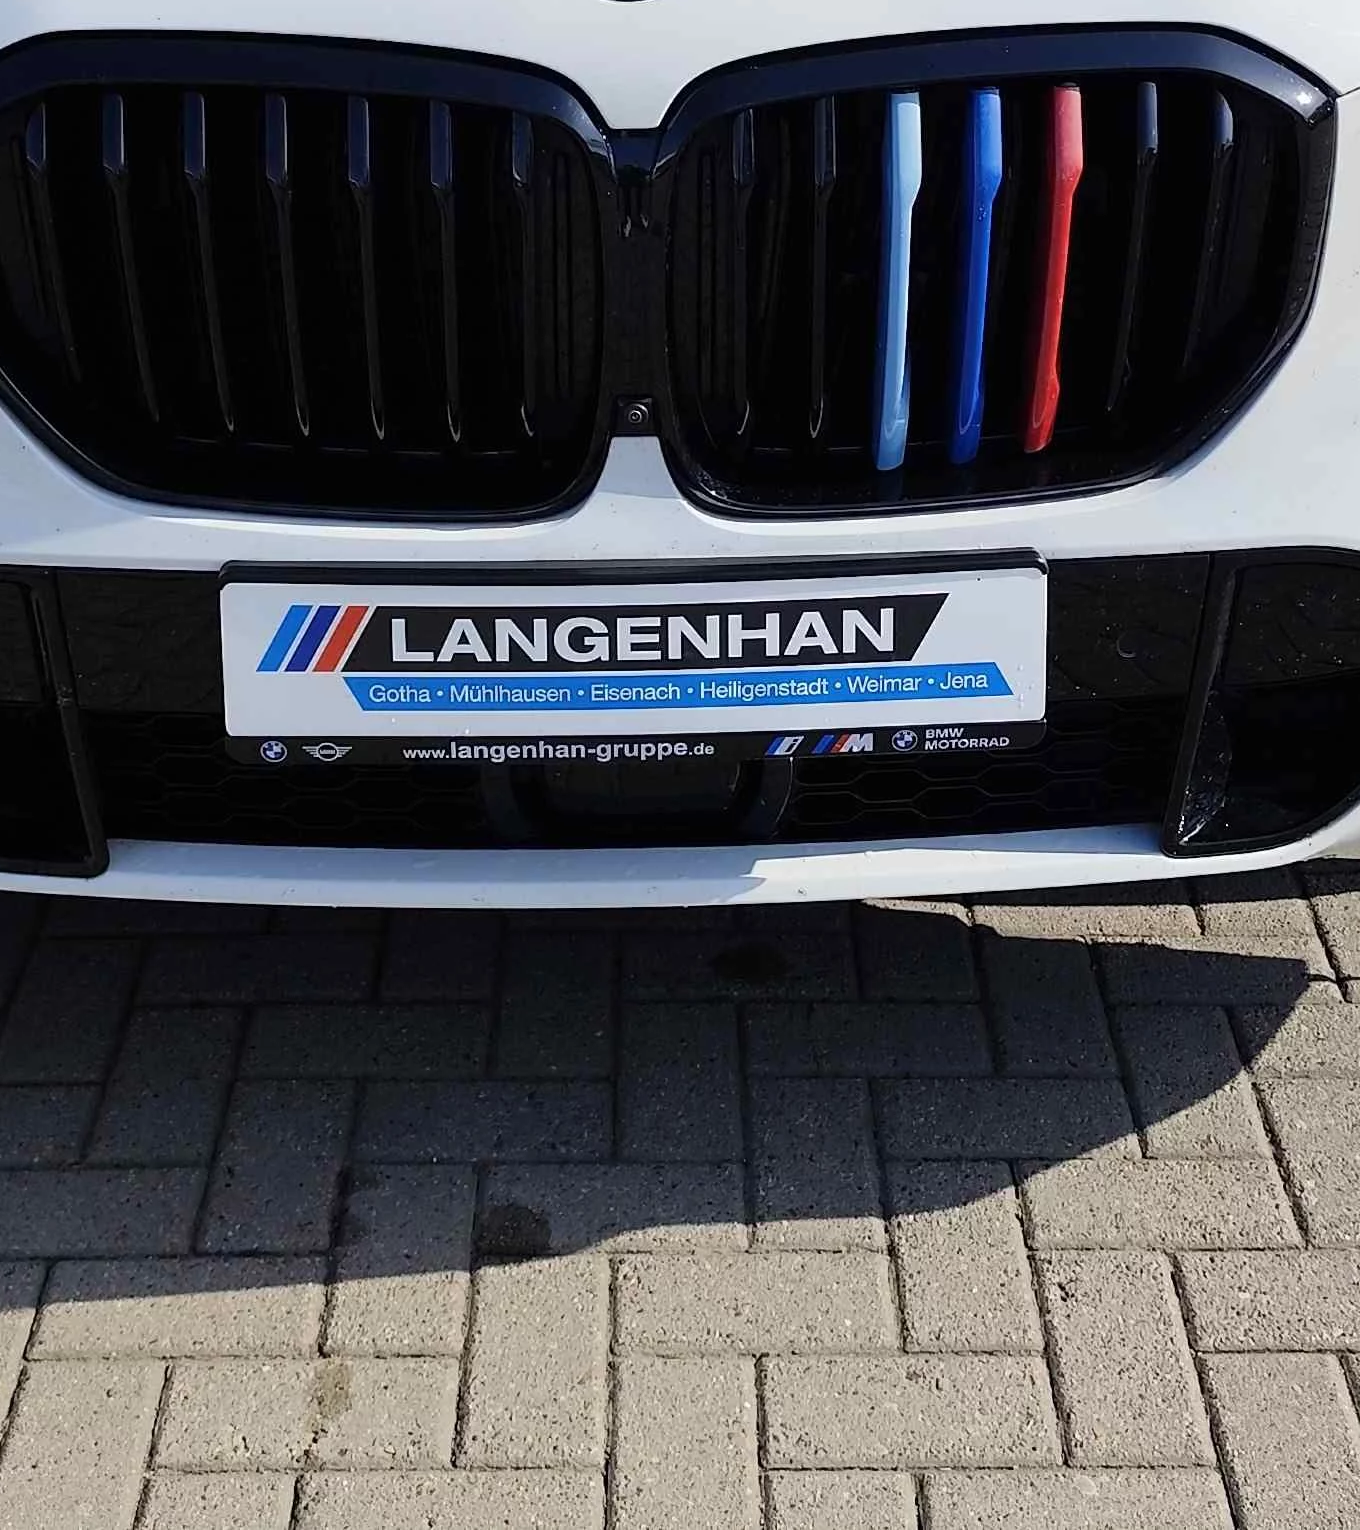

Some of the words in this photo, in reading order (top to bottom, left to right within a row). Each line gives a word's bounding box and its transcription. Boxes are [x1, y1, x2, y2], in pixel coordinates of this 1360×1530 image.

[391, 607, 895, 663] LANGENHAN
[368, 684, 432, 703] Gotha
[449, 684, 571, 703] Mühlhausen
[590, 682, 681, 701] Eisenach
[699, 678, 829, 702] Heiligenstadt
[847, 675, 922, 694] Weimar
[939, 672, 989, 690] Jena
[924, 736, 1010, 751] MOTORRAD
[925, 727, 965, 739] BMW
[402, 740, 715, 763] www.langenhan-gruppe.de
